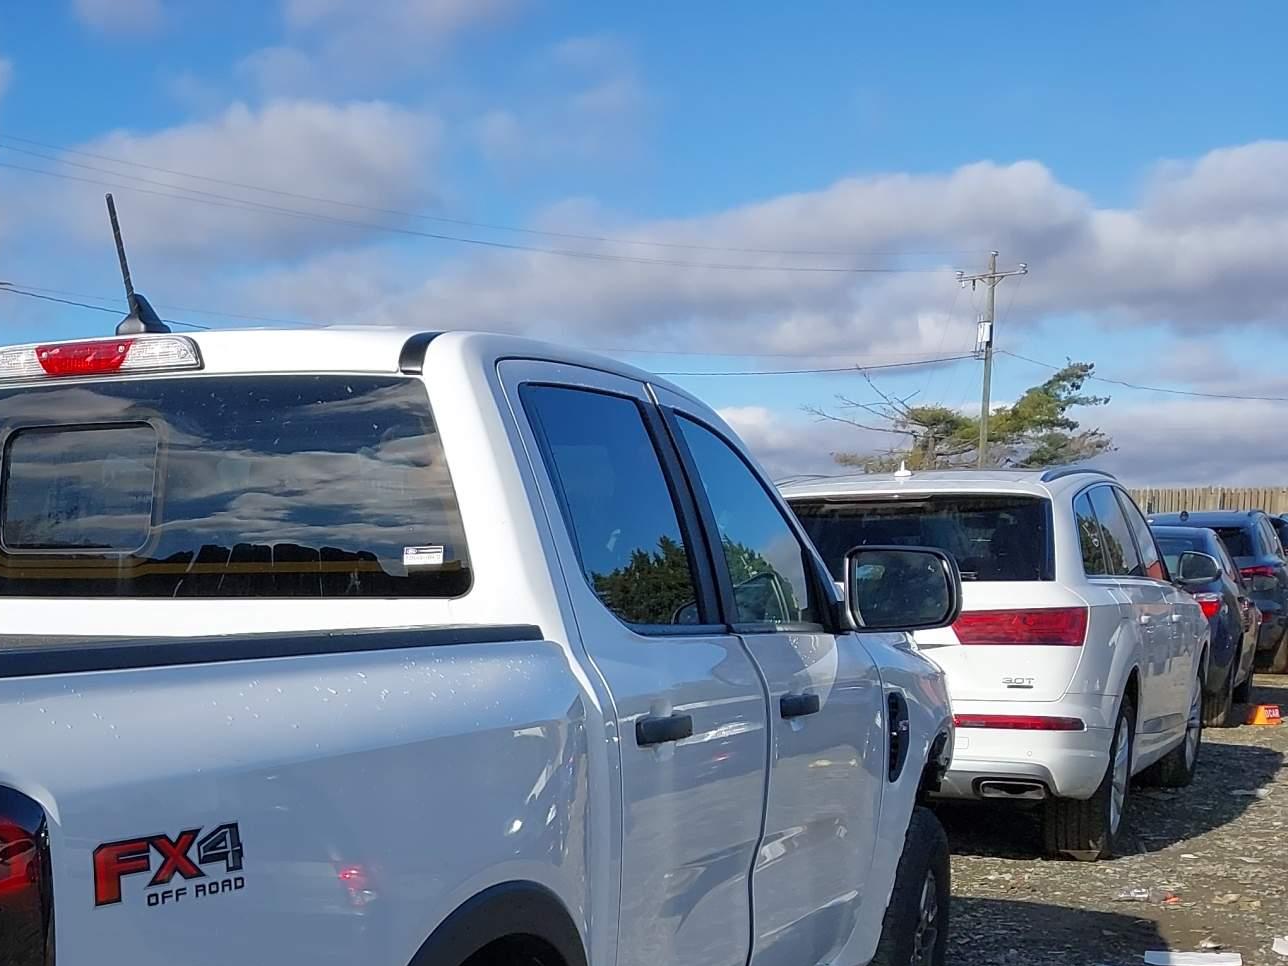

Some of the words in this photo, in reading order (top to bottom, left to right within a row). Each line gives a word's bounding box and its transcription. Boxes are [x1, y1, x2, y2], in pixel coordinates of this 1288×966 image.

[93, 822, 244, 907] FX4
[147, 887, 188, 907] OFF
[195, 877, 245, 898] ROAD
